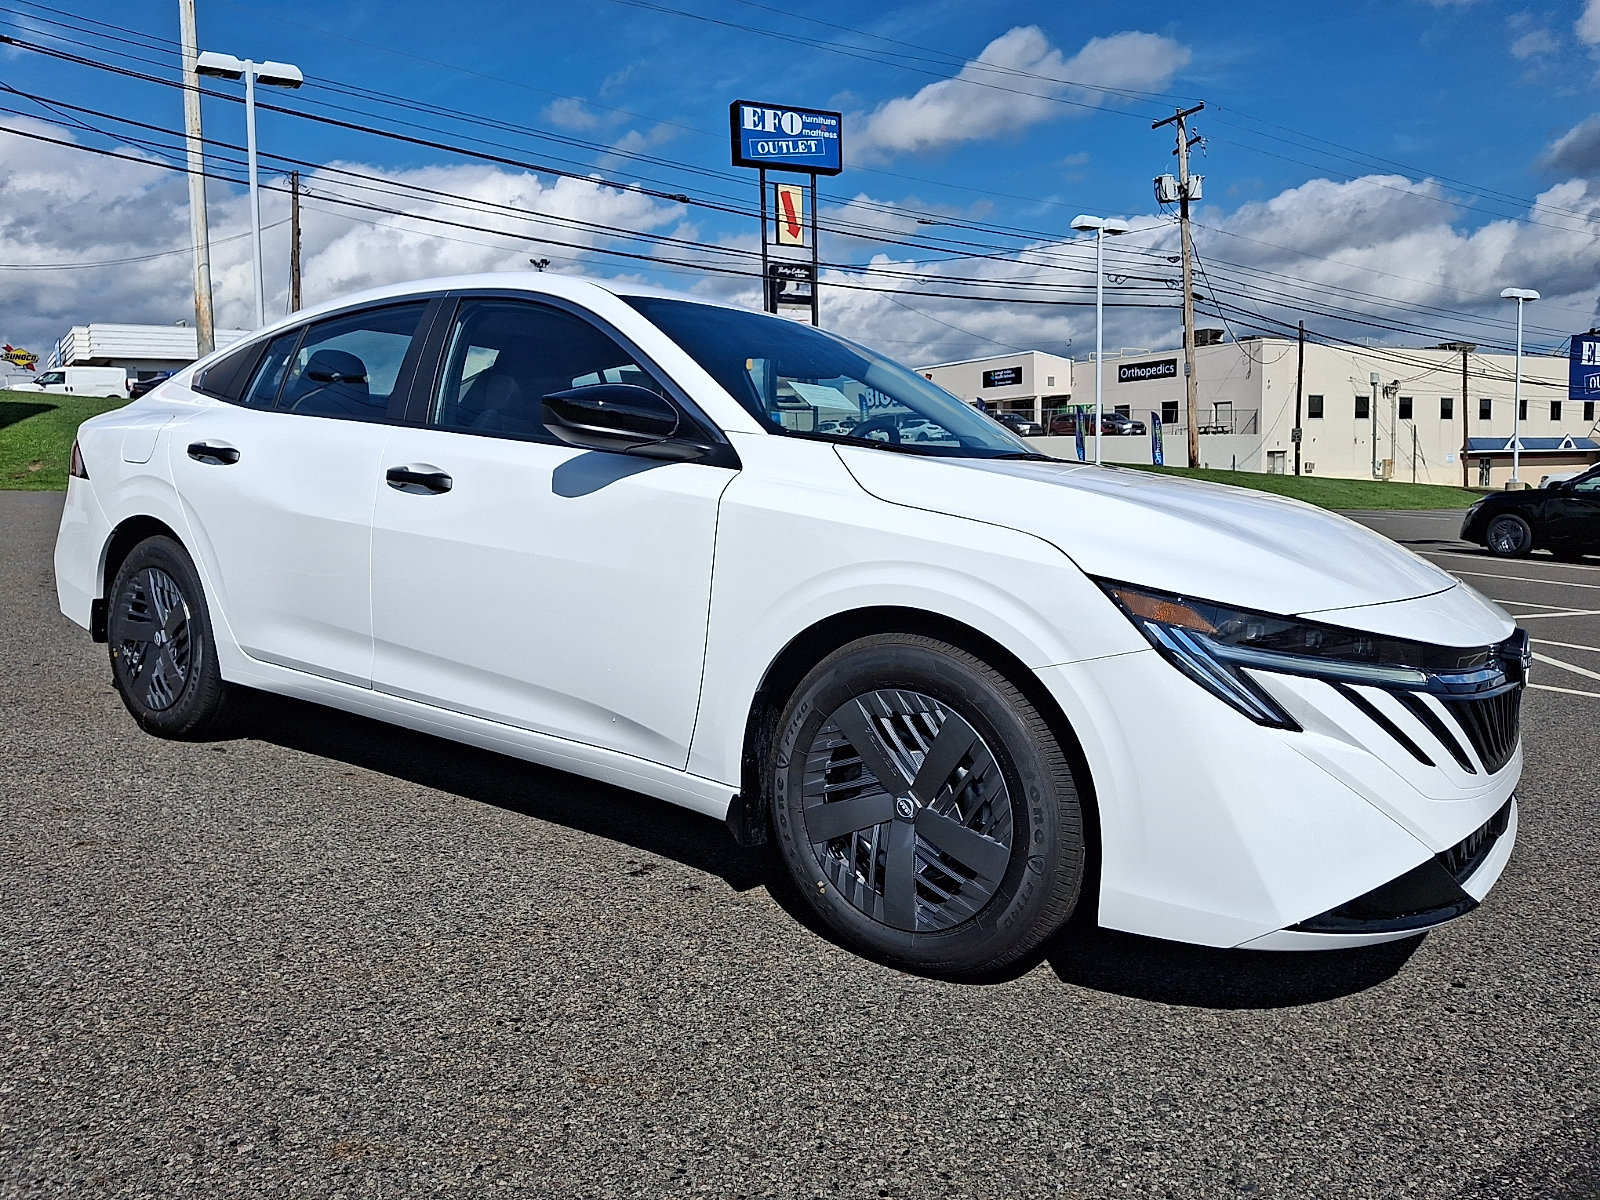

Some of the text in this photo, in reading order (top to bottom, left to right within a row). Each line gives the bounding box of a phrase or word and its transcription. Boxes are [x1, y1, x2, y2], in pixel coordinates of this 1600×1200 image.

[741, 106, 803, 136] EFO
[802, 114, 837, 126] furniture
[802, 128, 838, 139] mattress
[757, 140, 818, 154] OUTLET
[4, 353, 37, 361] SUNOCO
[1120, 363, 1175, 379] Orthopedics
